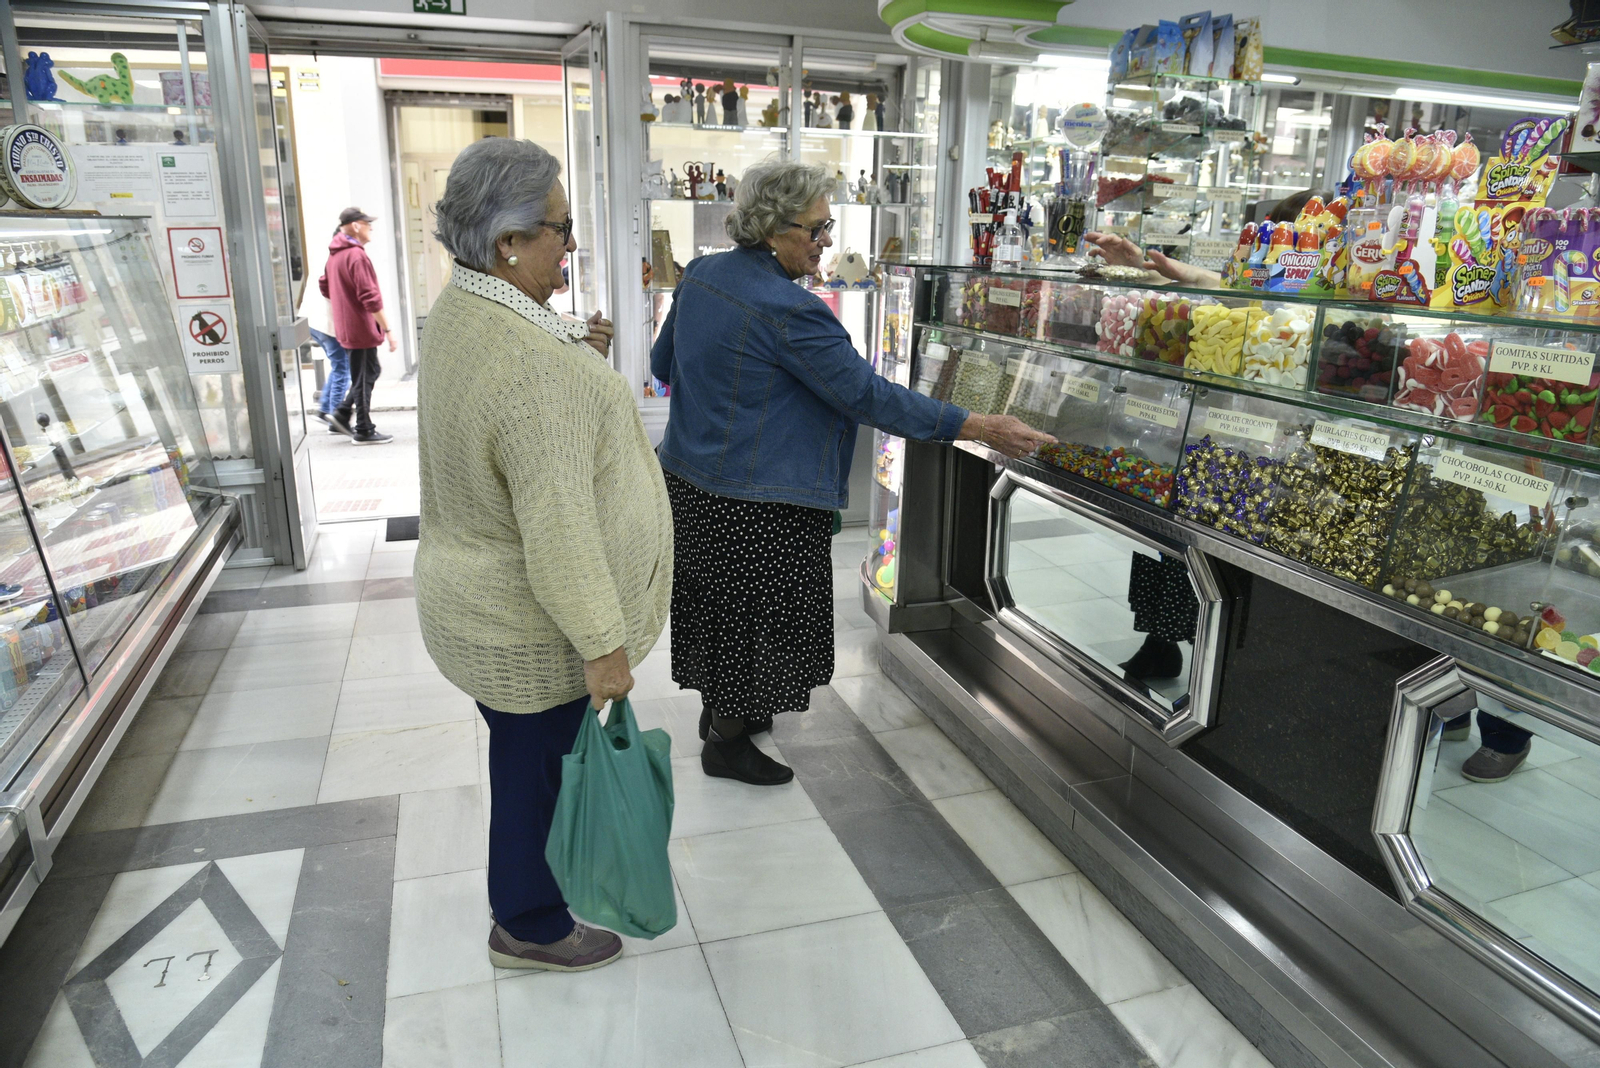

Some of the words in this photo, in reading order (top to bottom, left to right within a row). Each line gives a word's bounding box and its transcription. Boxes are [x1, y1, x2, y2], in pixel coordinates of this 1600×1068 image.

[12, 135, 27, 168] HORNO
[40, 134, 64, 168] CRISTO
[20, 174, 63, 183] ENSAIMADAS
[1490, 164, 1530, 184] Spiner
[1491, 175, 1528, 191] CANDY
[1281, 253, 1320, 268] UNICORN
[1285, 267, 1311, 280] SPRAY
[1456, 266, 1496, 288] Spiner
[1522, 271, 1542, 280] COLOR
[1250, 279, 1265, 288] SPRAY
[1401, 286, 1407, 296] 4
[1457, 279, 1490, 298] CANDY
[1495, 347, 1538, 360] GOMITAS
[1539, 352, 1590, 366] SURTIDAS
[1511, 361, 1530, 371] PVP.
[1532, 364, 1538, 372] 8
[1540, 365, 1553, 374] KL
[1126, 399, 1141, 408] JUDIAS
[1141, 403, 1162, 414] COLORES
[1162, 408, 1179, 418] EXTRA
[1208, 411, 1241, 423] CHOCOLATE
[1220, 422, 1231, 430] PVP.
[1315, 424, 1358, 440] GUIRLACHES
[1360, 433, 1387, 447] CHOCO.
[1441, 455, 1503, 479] CHOCOBOLAS
[1503, 473, 1549, 492] COLORES
[1452, 470, 1471, 483] PVP.
[1472, 476, 1508, 494] 14.50.KL
